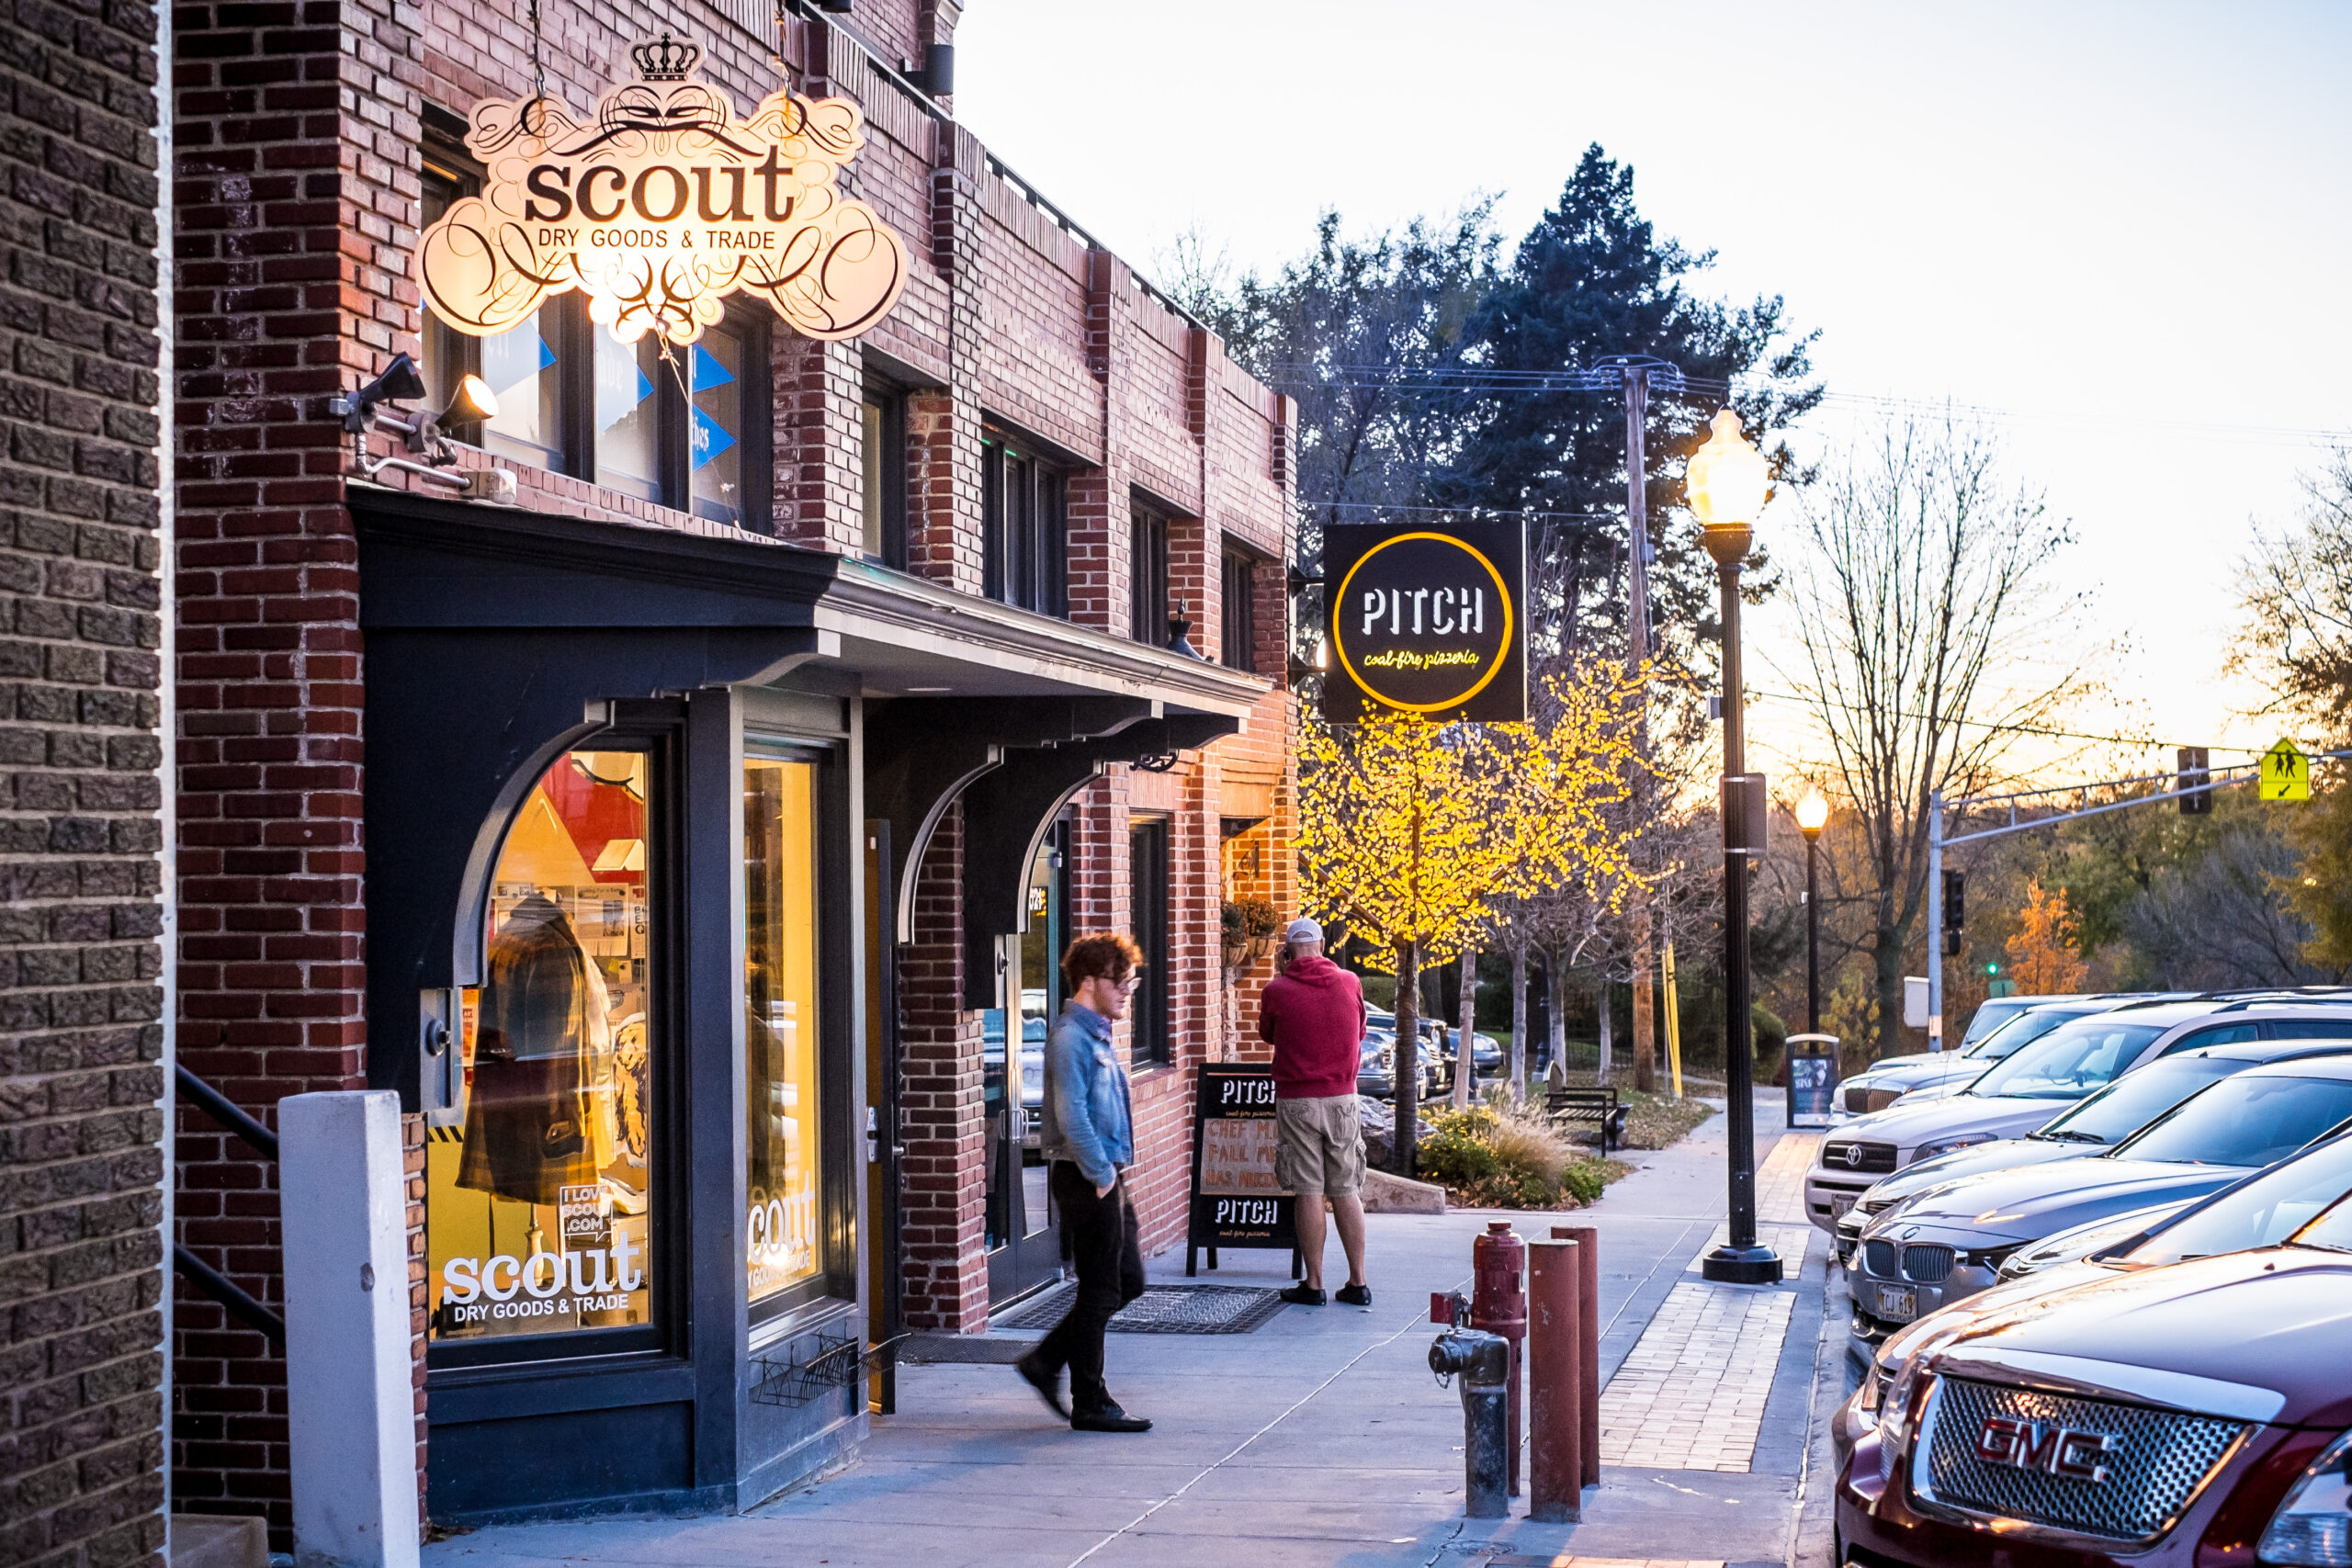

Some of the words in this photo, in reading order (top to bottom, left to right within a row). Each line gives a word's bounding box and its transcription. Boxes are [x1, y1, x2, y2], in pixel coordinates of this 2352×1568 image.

[525, 144, 795, 222] scout
[538, 229, 579, 247] DRY
[591, 229, 668, 248] GOODS
[681, 231, 693, 248] &
[707, 231, 775, 249] TRADE
[1362, 587, 1483, 635] PITCH
[1363, 649, 1423, 670] coal-fire
[1423, 649, 1479, 670] pizzeria
[1208, 1120, 1247, 1139] CHEF
[1208, 1144, 1249, 1163] FALL
[1205, 1169, 1234, 1187] HAS
[564, 1190, 569, 1202] I
[747, 1170, 815, 1266] cout
[1215, 1199, 1278, 1224] PITCH
[443, 1231, 641, 1305] scout
[454, 1304, 490, 1323] DRY
[492, 1300, 555, 1320] GOODS
[558, 1298, 570, 1314] &
[573, 1293, 628, 1314] TRADE
[1976, 1417, 2111, 1483] GMC
